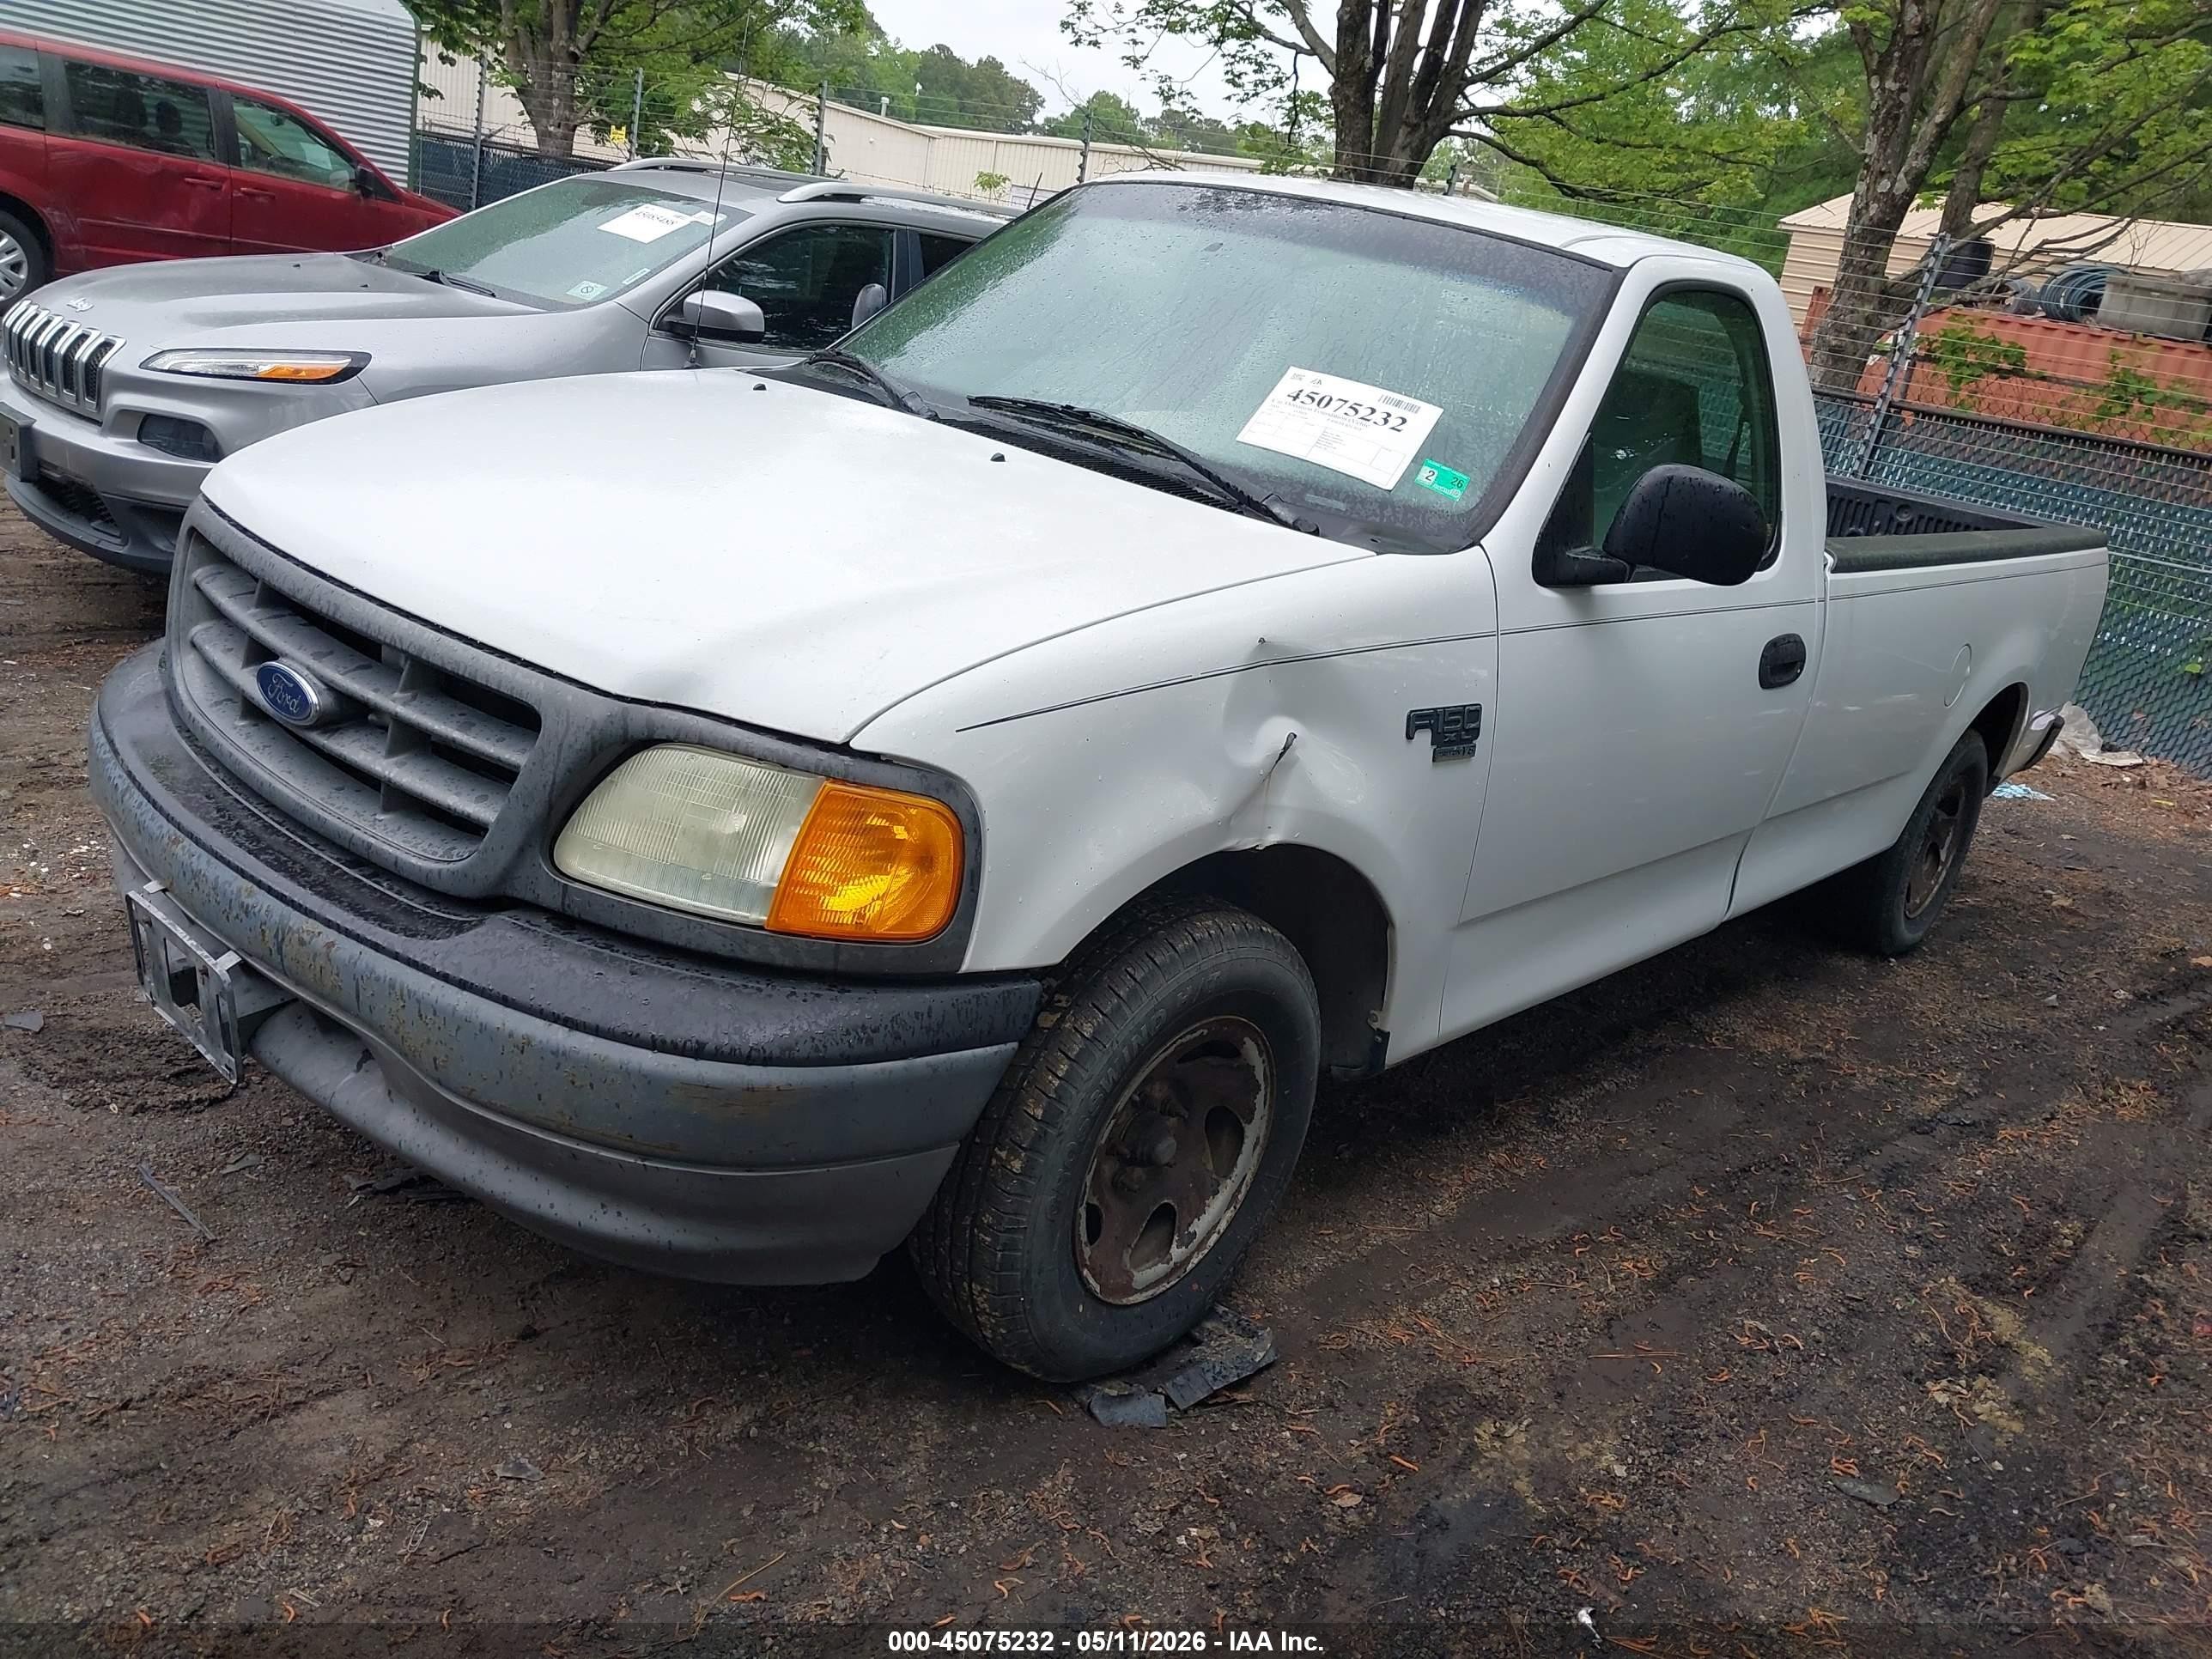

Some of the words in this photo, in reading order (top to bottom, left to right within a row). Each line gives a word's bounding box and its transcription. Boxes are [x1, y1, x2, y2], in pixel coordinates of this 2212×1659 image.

[1287, 388, 1407, 433] 45075232
[1425, 470, 1436, 482] 2
[1450, 477, 1465, 489] 26
[267, 672, 301, 714] Ford
